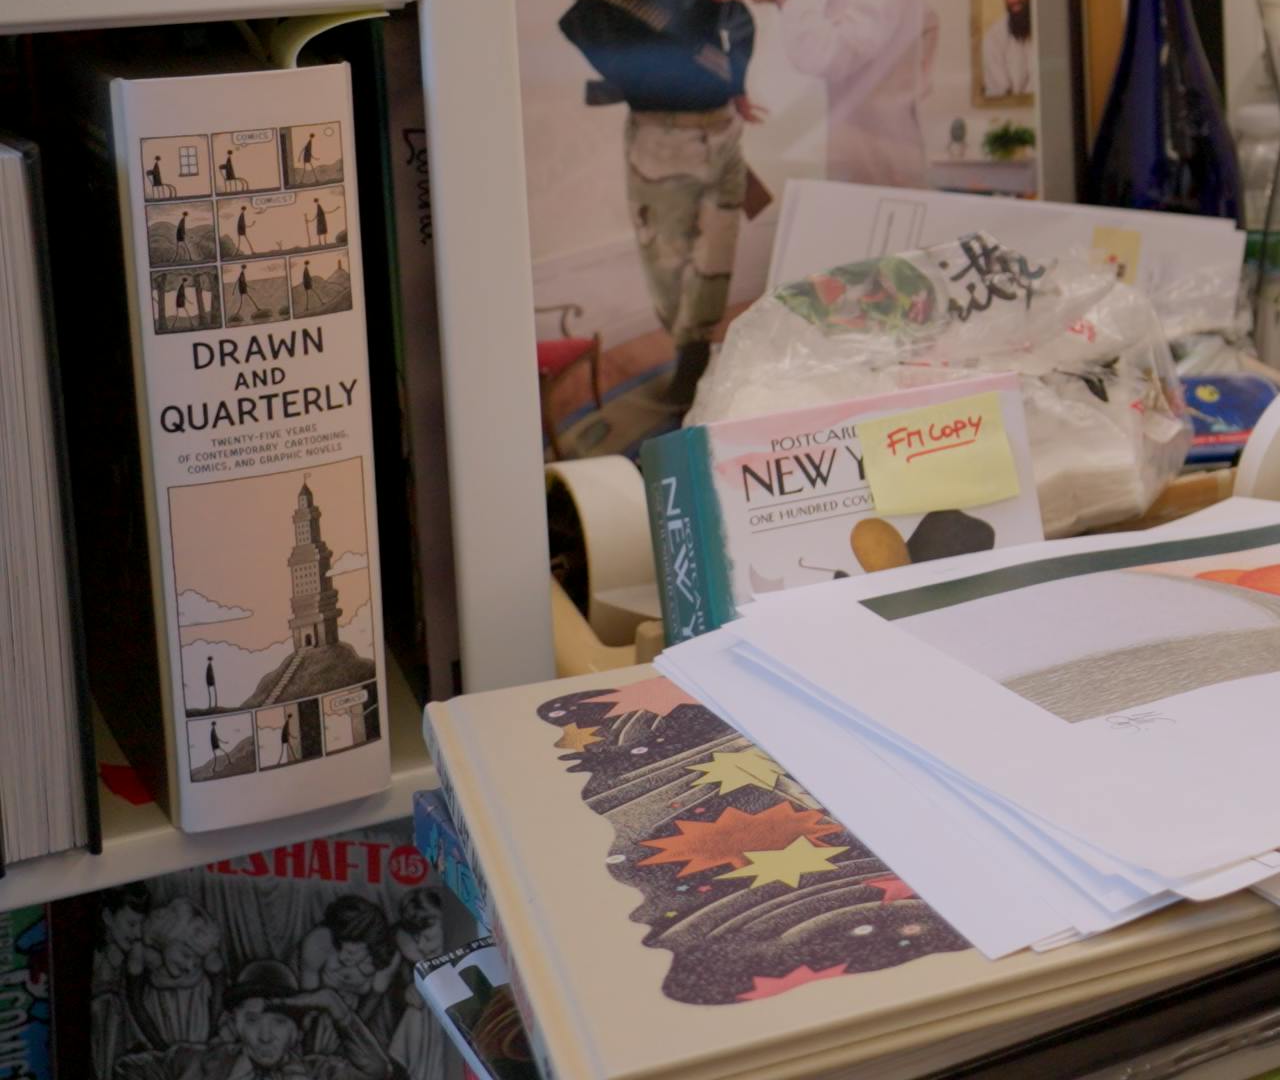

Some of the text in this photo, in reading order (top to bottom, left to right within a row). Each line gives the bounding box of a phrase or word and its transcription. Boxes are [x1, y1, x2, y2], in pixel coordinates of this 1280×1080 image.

[192, 326, 324, 370] DRAWN
[234, 366, 286, 391] AND
[160, 378, 358, 434] QUARTERLY
[211, 423, 318, 448] TWENTY-FIVE YEARS
[177, 455, 192, 465] OF
[195, 442, 278, 462] CONTEMPORARY
[187, 442, 343, 475] COMICS, AND GRAPHIC NOVELS
[741, 447, 838, 503] NEW
[749, 512, 774, 527] ONE
[777, 500, 838, 522] HUNDRED
[661, 474, 696, 604] NEW
